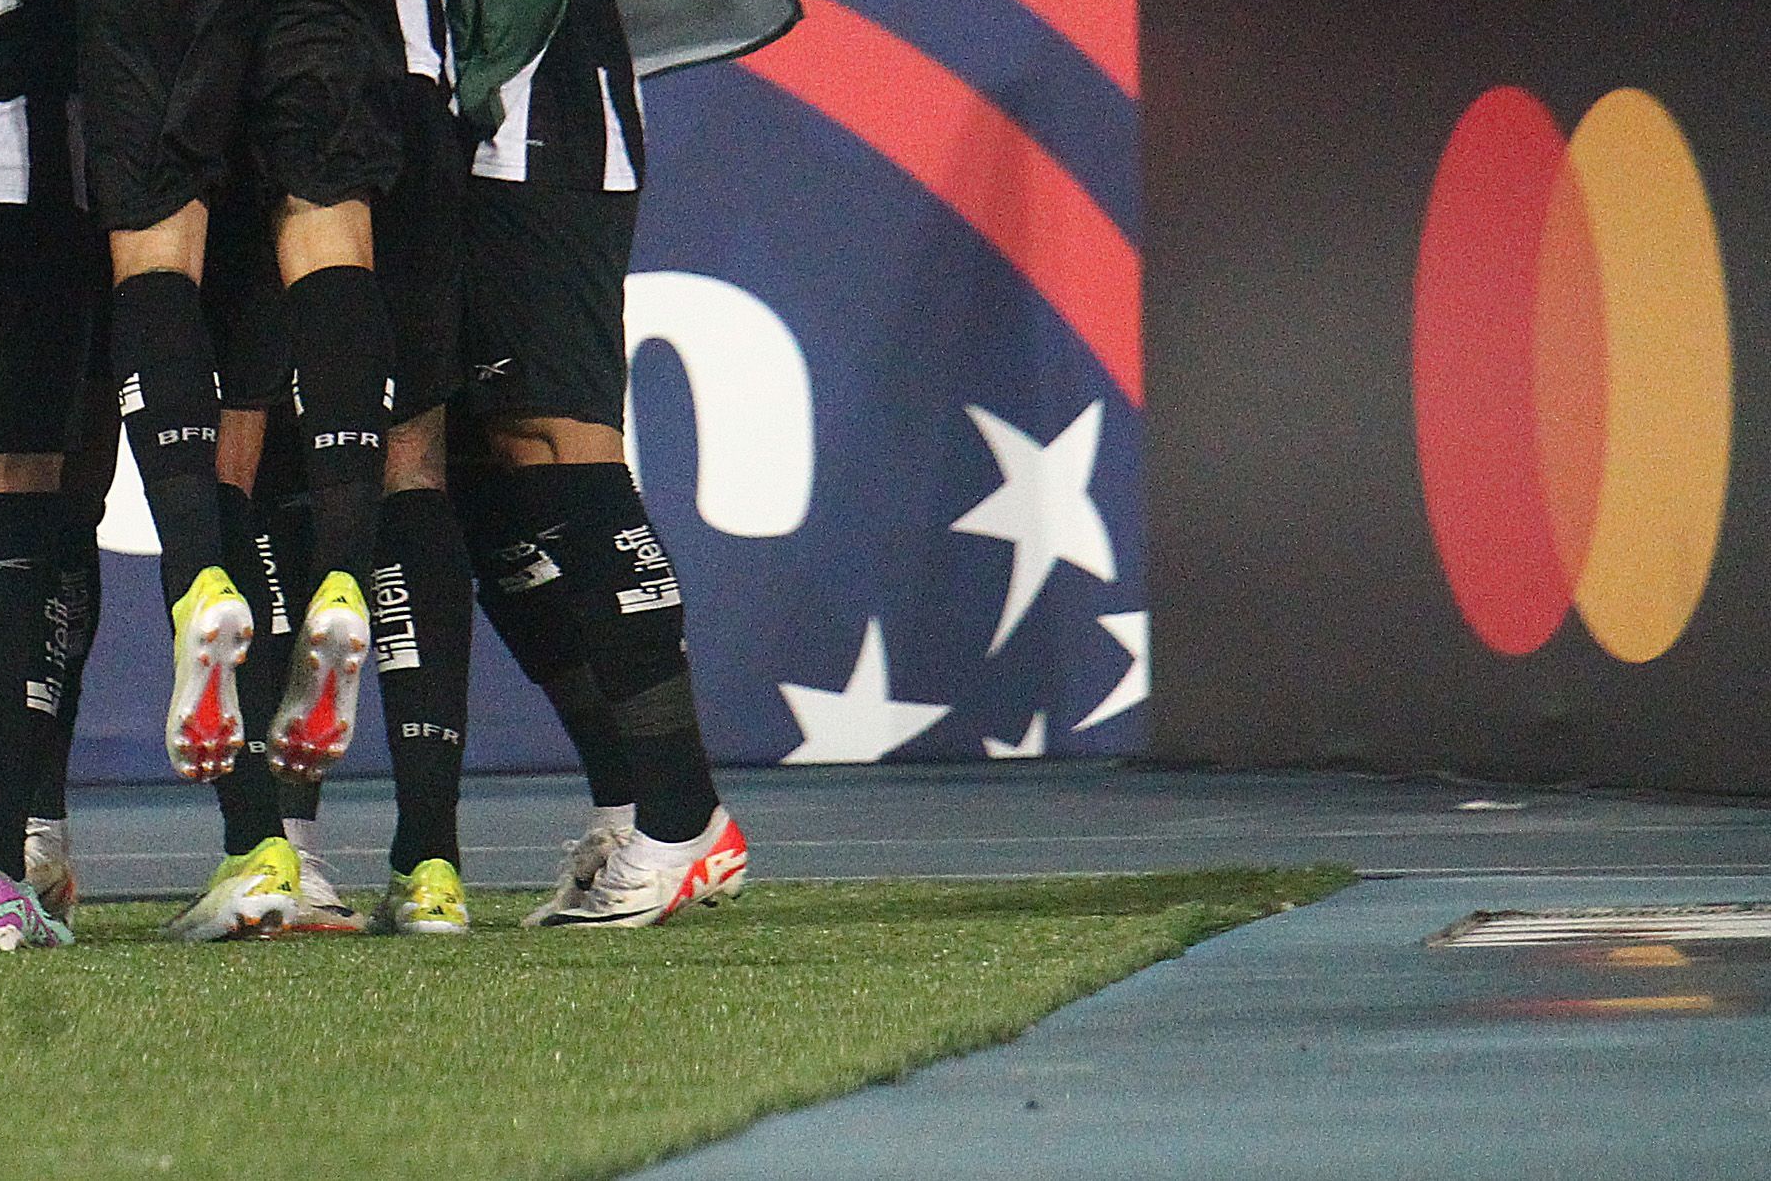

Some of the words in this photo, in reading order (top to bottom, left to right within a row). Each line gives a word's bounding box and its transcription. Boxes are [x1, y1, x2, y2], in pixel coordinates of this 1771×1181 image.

[157, 426, 218, 447] BFR
[314, 430, 380, 450] BFR
[402, 722, 460, 745] BFR
